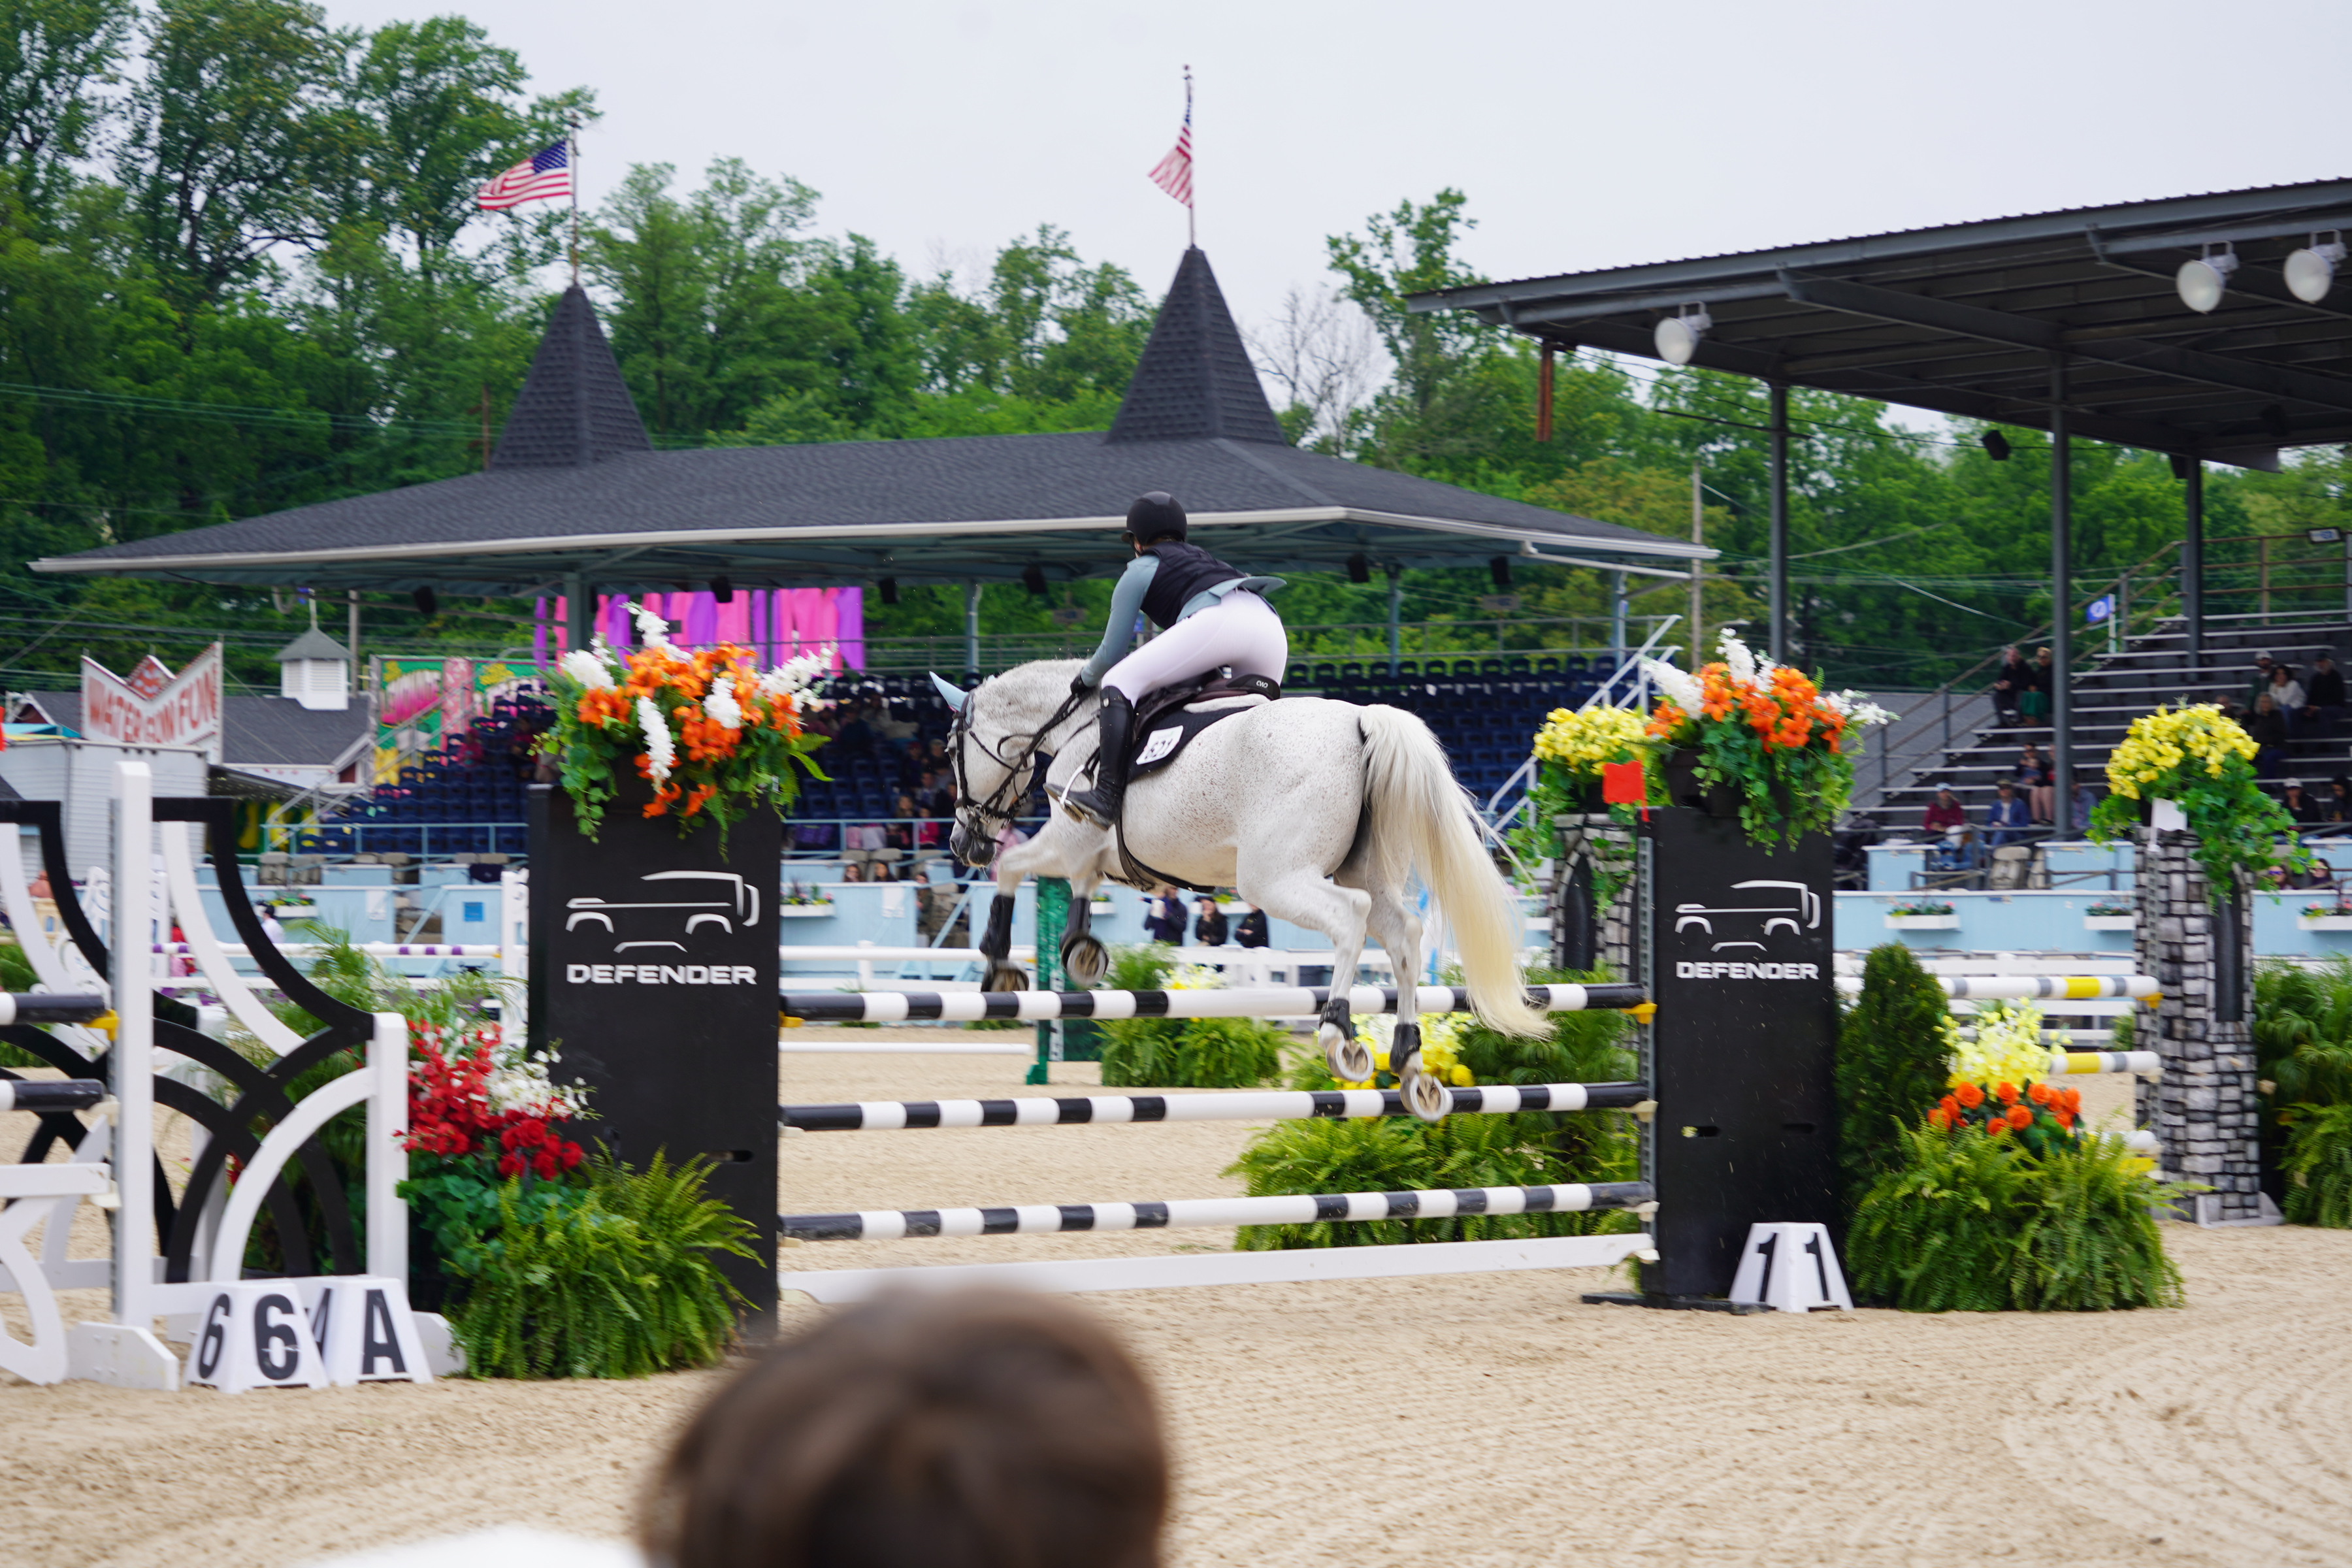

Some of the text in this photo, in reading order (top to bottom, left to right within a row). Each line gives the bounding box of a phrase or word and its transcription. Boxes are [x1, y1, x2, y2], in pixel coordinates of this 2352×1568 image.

[178, 664, 216, 737] FUN
[566, 964, 757, 985] DEFENDER
[1676, 962, 1819, 980] DEFENDER
[199, 1293, 232, 1379] 6
[254, 1294, 298, 1380] 6
[362, 1289, 406, 1374] A
